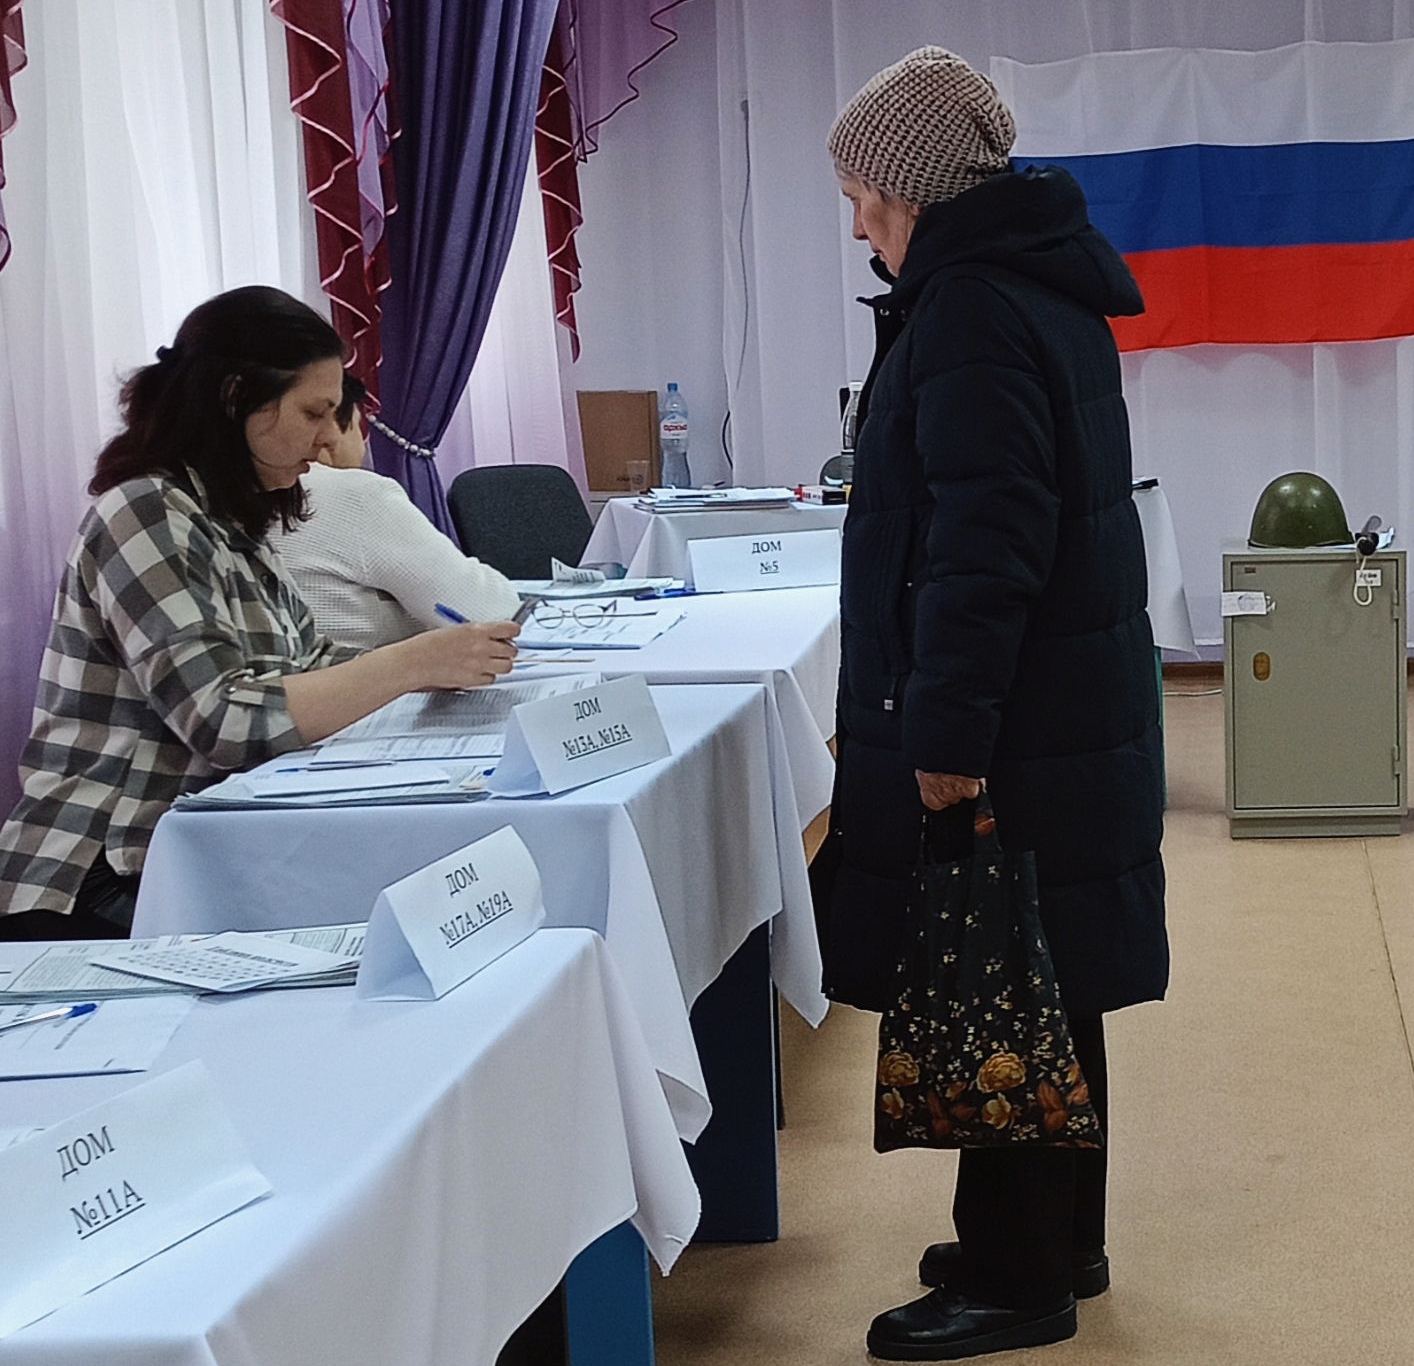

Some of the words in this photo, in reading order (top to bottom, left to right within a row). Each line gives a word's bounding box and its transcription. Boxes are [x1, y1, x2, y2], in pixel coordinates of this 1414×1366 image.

[752, 540, 782, 554] ДОМ
[760, 560, 779, 573] №5
[573, 697, 602, 722] ДОМ
[562, 734, 599, 758] №13А,
[598, 723, 631, 746] №15А
[445, 863, 479, 898] ДОМ
[439, 912, 478, 945] №17А,
[476, 890, 513, 924] №19А
[57, 1126, 115, 1182] ДОМ
[69, 1180, 143, 1234] №11А
